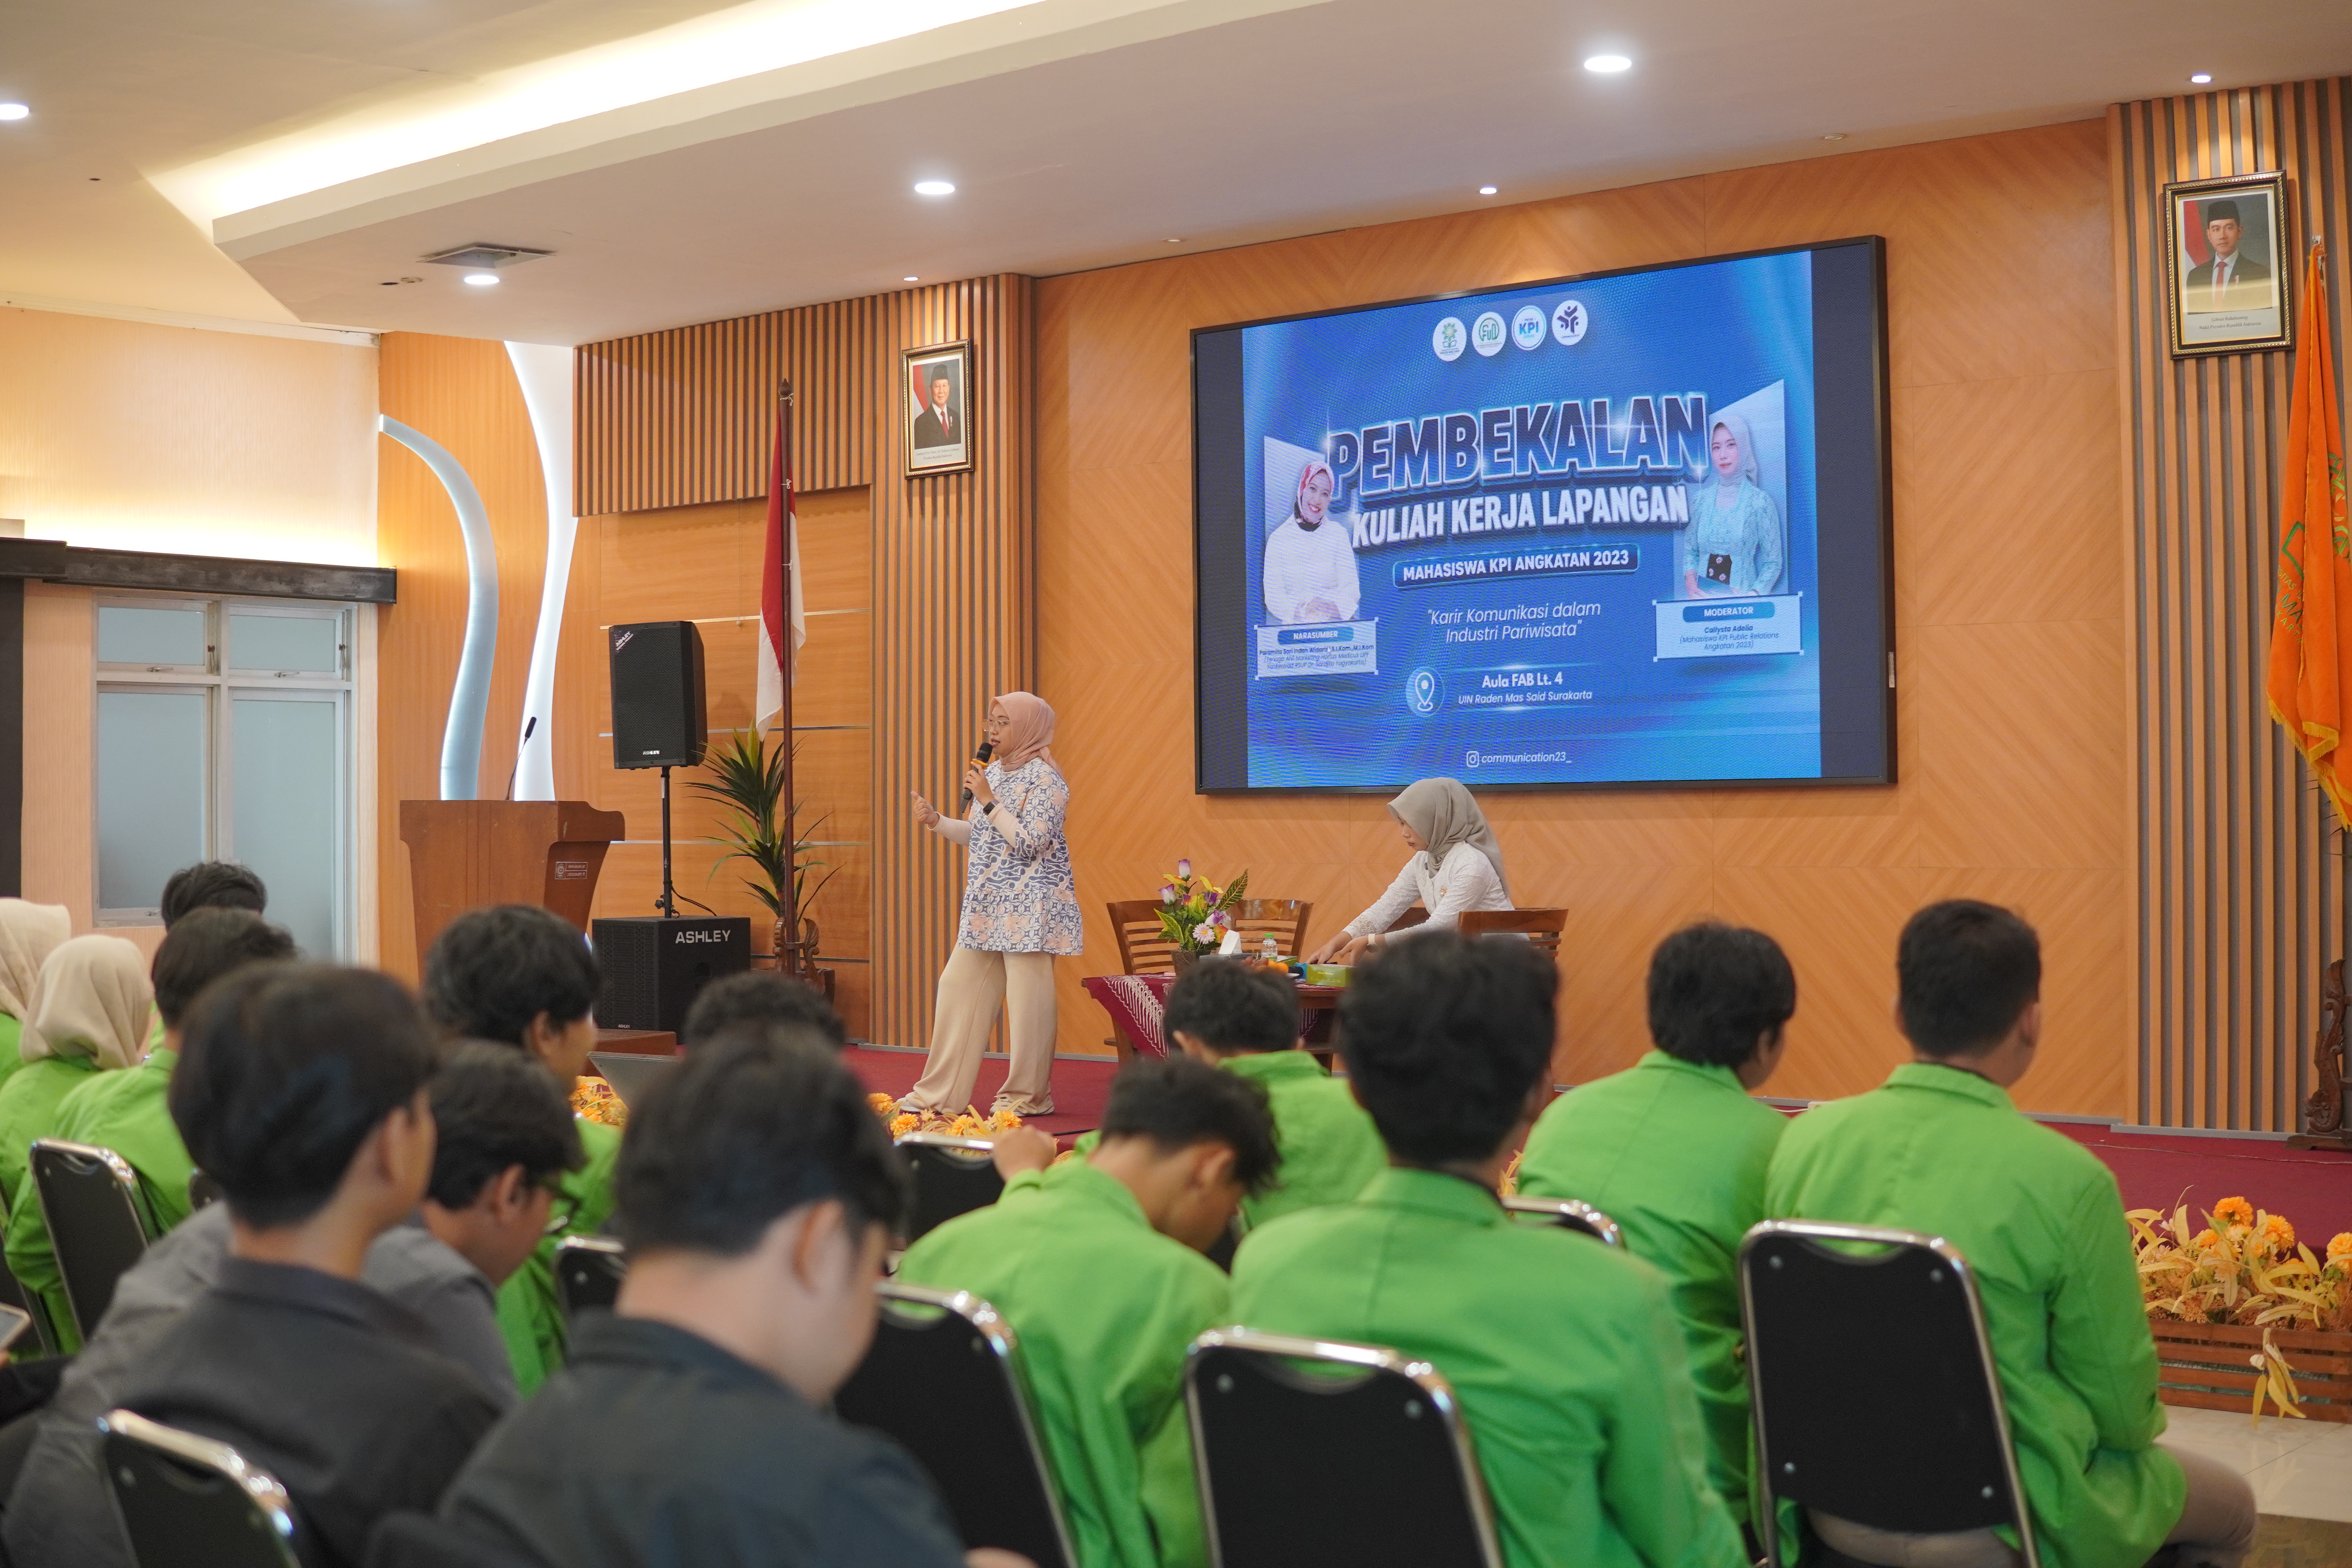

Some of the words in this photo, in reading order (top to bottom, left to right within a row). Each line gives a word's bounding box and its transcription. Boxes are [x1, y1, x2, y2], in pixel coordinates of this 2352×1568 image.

[1519, 321, 1539, 335] KPI
[1328, 393, 1709, 499] PEMBEKALAN
[1352, 501, 1444, 548] KULIAH
[1451, 492, 1536, 535] KERJA
[1542, 485, 1690, 526] LAPANGAN
[1403, 559, 1486, 581] MAHASISWA
[1489, 557, 1512, 573] KPI
[1514, 552, 1590, 571] ANGKATAN
[1593, 549, 1629, 566] 2023
[1428, 609, 1463, 624] "Karir
[1466, 603, 1549, 623] Komunikasi
[1552, 601, 1601, 618] dalam
[1704, 606, 1754, 617] MODERATOR
[1293, 631, 1338, 640] NARASUMBER
[1446, 626, 1498, 643] Industri
[1501, 619, 1583, 640] Pariwisata"
[1704, 643, 1734, 651] Angkatan
[1482, 675, 1509, 688] Aula
[1512, 673, 1534, 687] FAB
[1537, 673, 1552, 685] Lt.
[1554, 671, 1563, 684] 4
[1458, 695, 1473, 704] UIN
[1475, 693, 1503, 704] Raden
[1505, 693, 1524, 702] Mas
[1526, 691, 1546, 702] Said
[1548, 690, 1593, 701] Surakarta
[1481, 751, 1572, 763] communication23_
[675, 930, 731, 944] ASHLEY
